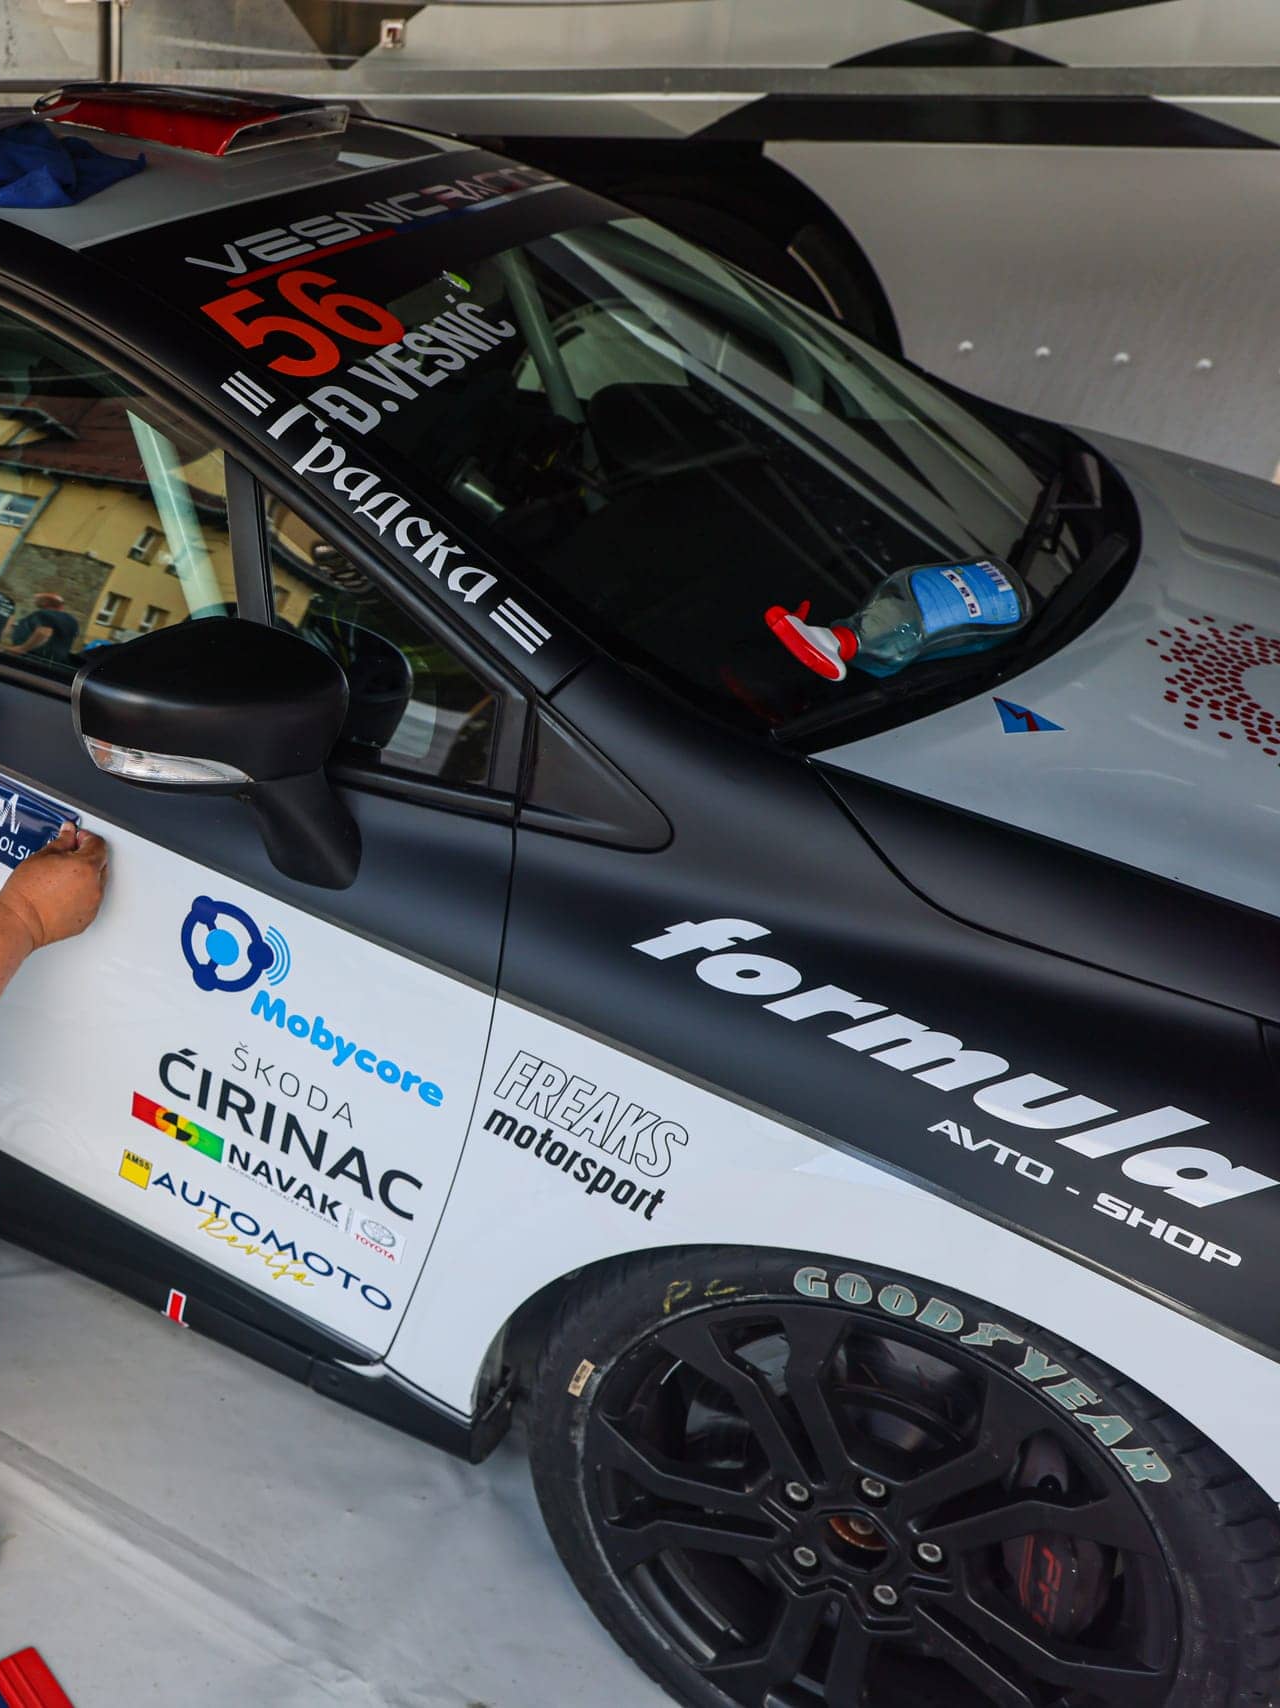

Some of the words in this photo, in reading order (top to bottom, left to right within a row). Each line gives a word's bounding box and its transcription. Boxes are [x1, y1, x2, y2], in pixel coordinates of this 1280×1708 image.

[185, 192, 449, 275] VESNIC
[200, 269, 406, 377] 56
[266, 403, 498, 604] Градска
[231, 1041, 353, 1129] ŠKODA
[250, 990, 445, 1108] Mobycore
[631, 918, 1280, 1209] formula
[125, 1152, 151, 1171] AMSS
[158, 1048, 424, 1221] ĆIRINAC
[483, 1108, 666, 1222] motorsport
[493, 1050, 689, 1178] FREAKS
[228, 1144, 343, 1222] NAVAK
[928, 1118, 1054, 1187] AVTO
[1091, 1191, 1244, 1269] SHOP
[151, 1172, 393, 1312] AUTOMOTO
[354, 1233, 396, 1262] TOYOTA
